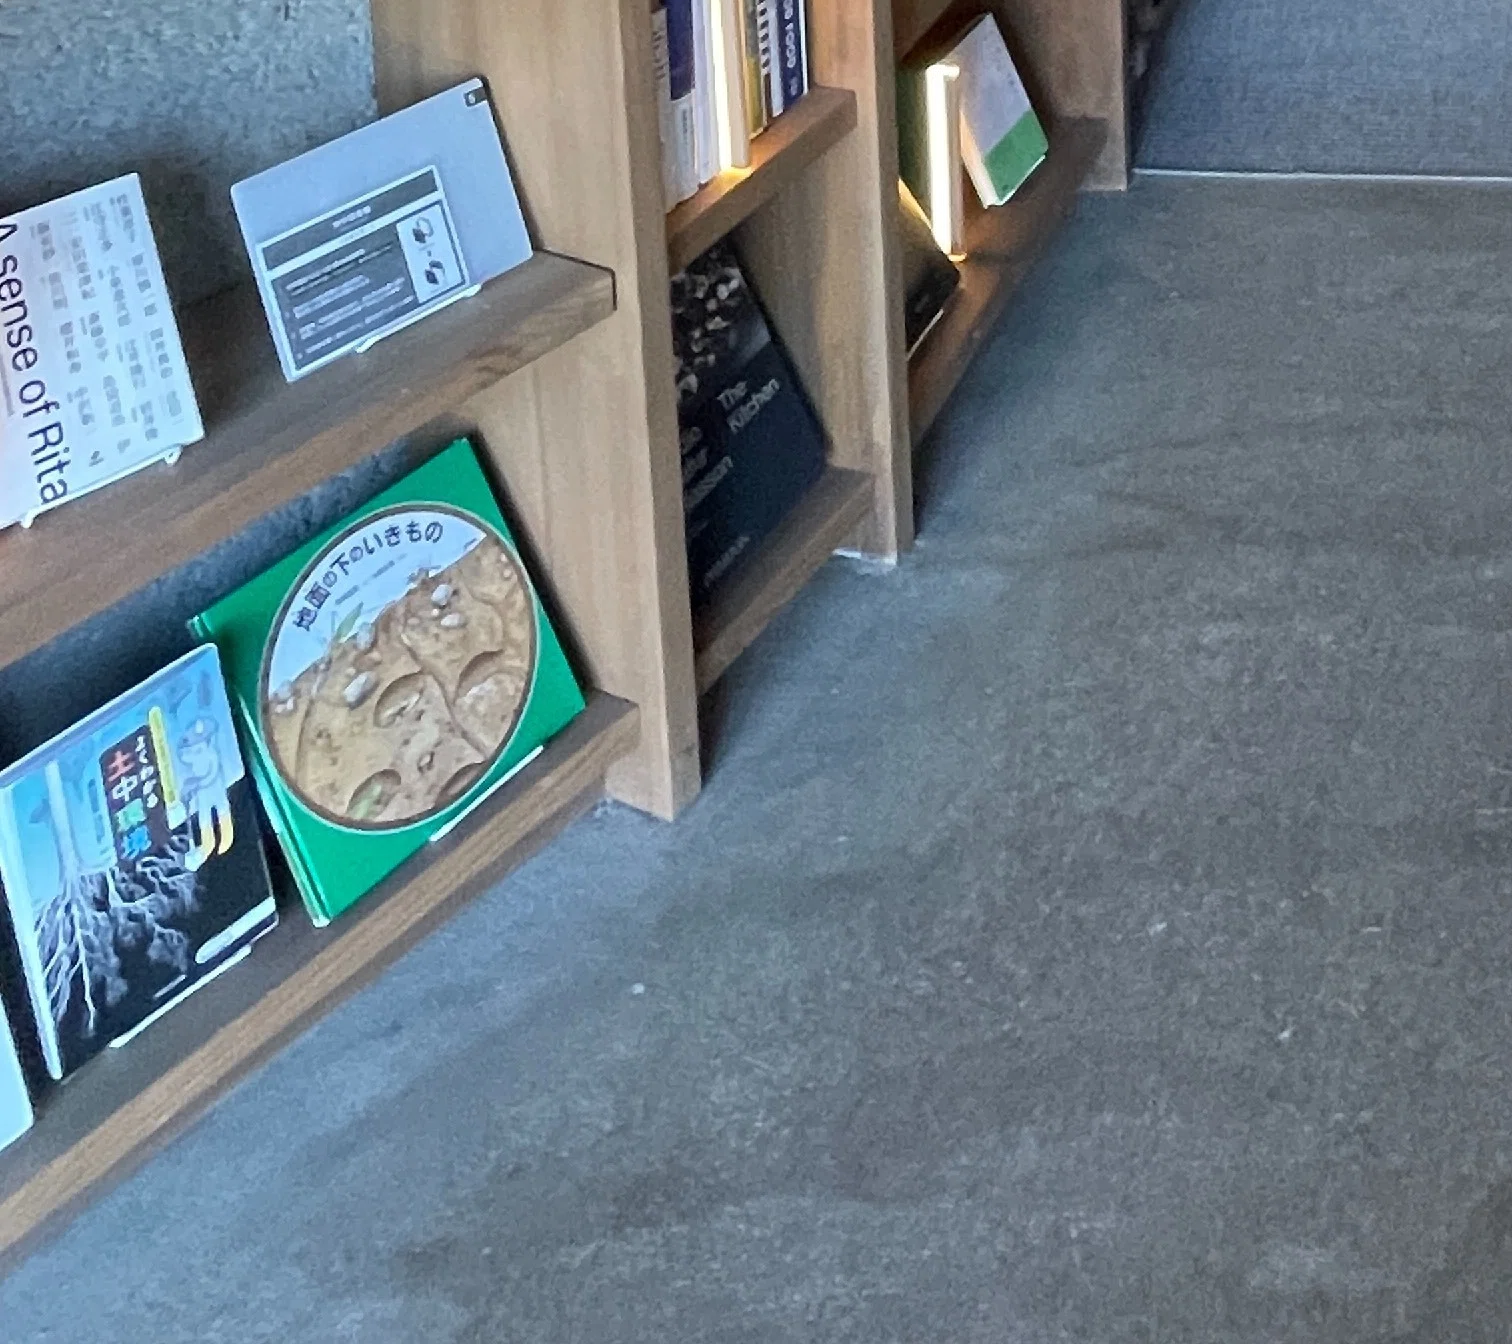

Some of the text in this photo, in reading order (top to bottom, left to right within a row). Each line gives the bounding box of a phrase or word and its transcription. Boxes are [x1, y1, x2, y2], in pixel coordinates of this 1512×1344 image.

[0, 254, 39, 373] sense
[18, 379, 61, 419] of
[27, 420, 72, 505] Rita
[291, 519, 445, 633] 地面の下のいきもの
